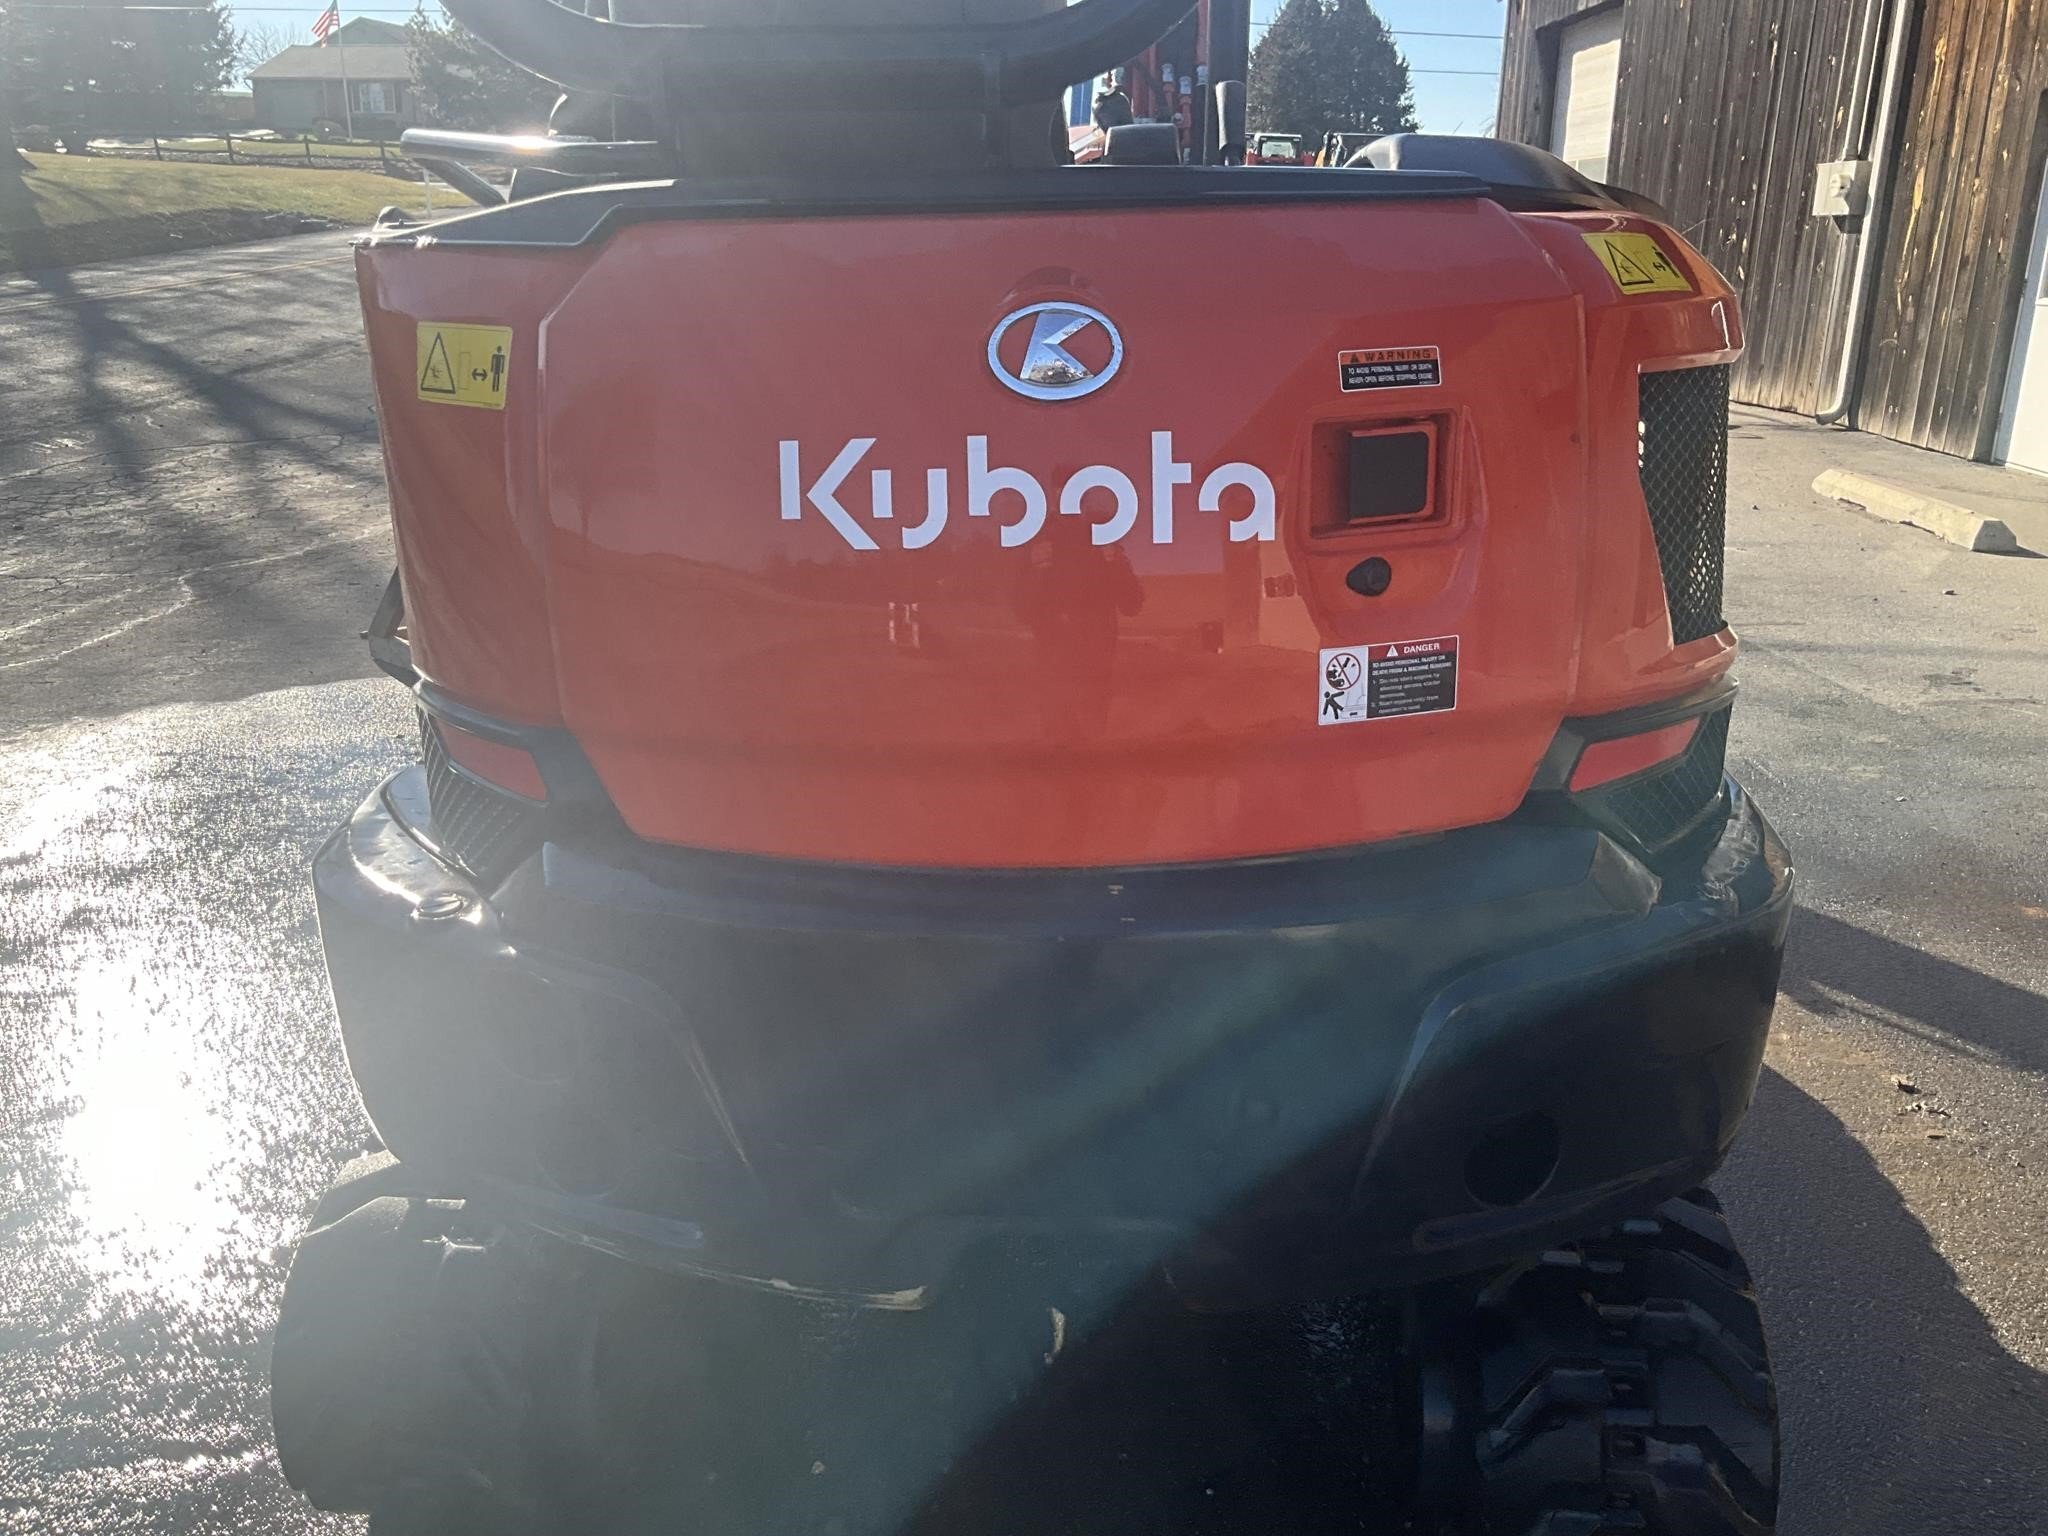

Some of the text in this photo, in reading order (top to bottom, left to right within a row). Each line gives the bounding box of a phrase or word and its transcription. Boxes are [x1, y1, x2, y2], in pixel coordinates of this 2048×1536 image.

[1364, 349, 1431, 361] WARNING
[779, 430, 1276, 551] Kubota
[1403, 642, 1440, 654] DANGER
